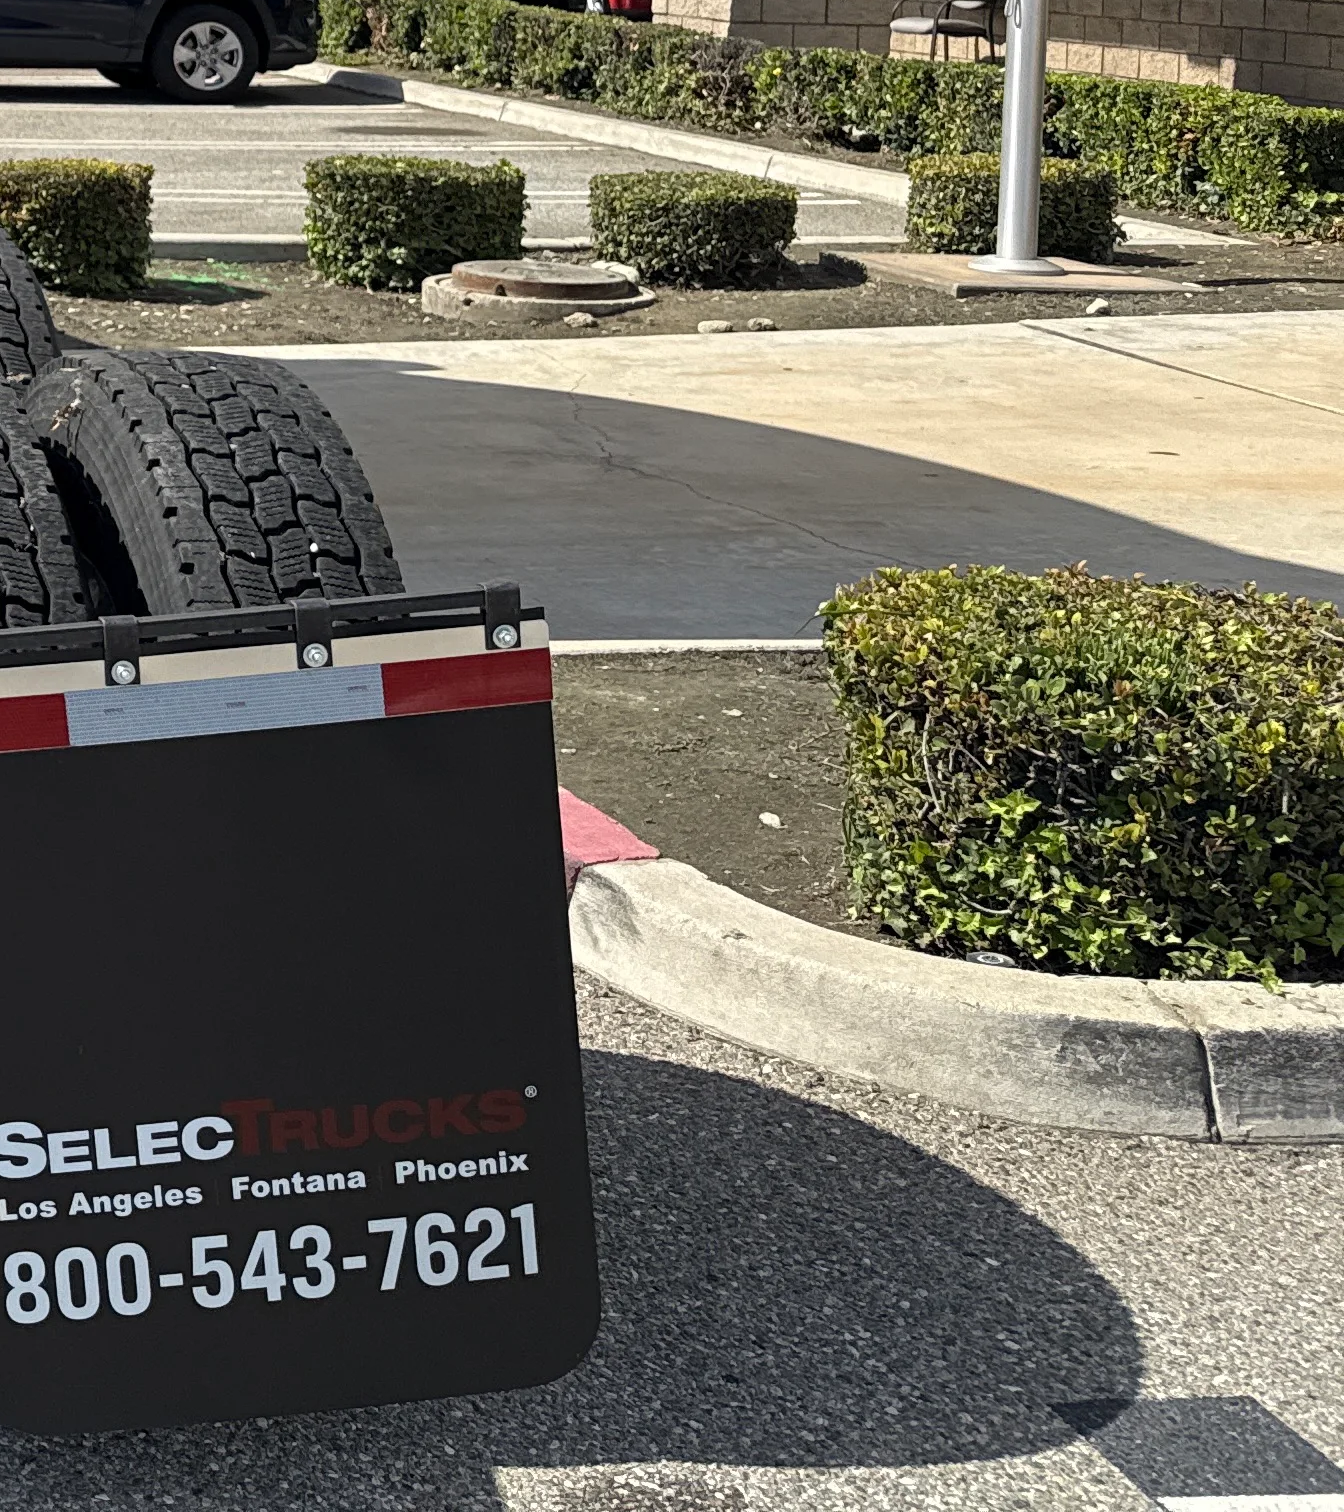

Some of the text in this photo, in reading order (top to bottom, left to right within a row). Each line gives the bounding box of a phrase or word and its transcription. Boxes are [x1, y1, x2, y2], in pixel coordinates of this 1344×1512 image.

[68, 1184, 204, 1217] Angeles
[231, 1170, 367, 1200] Fontana
[394, 1150, 530, 1184] Phoenix
[3, 1203, 539, 1324] 800-543-7621
